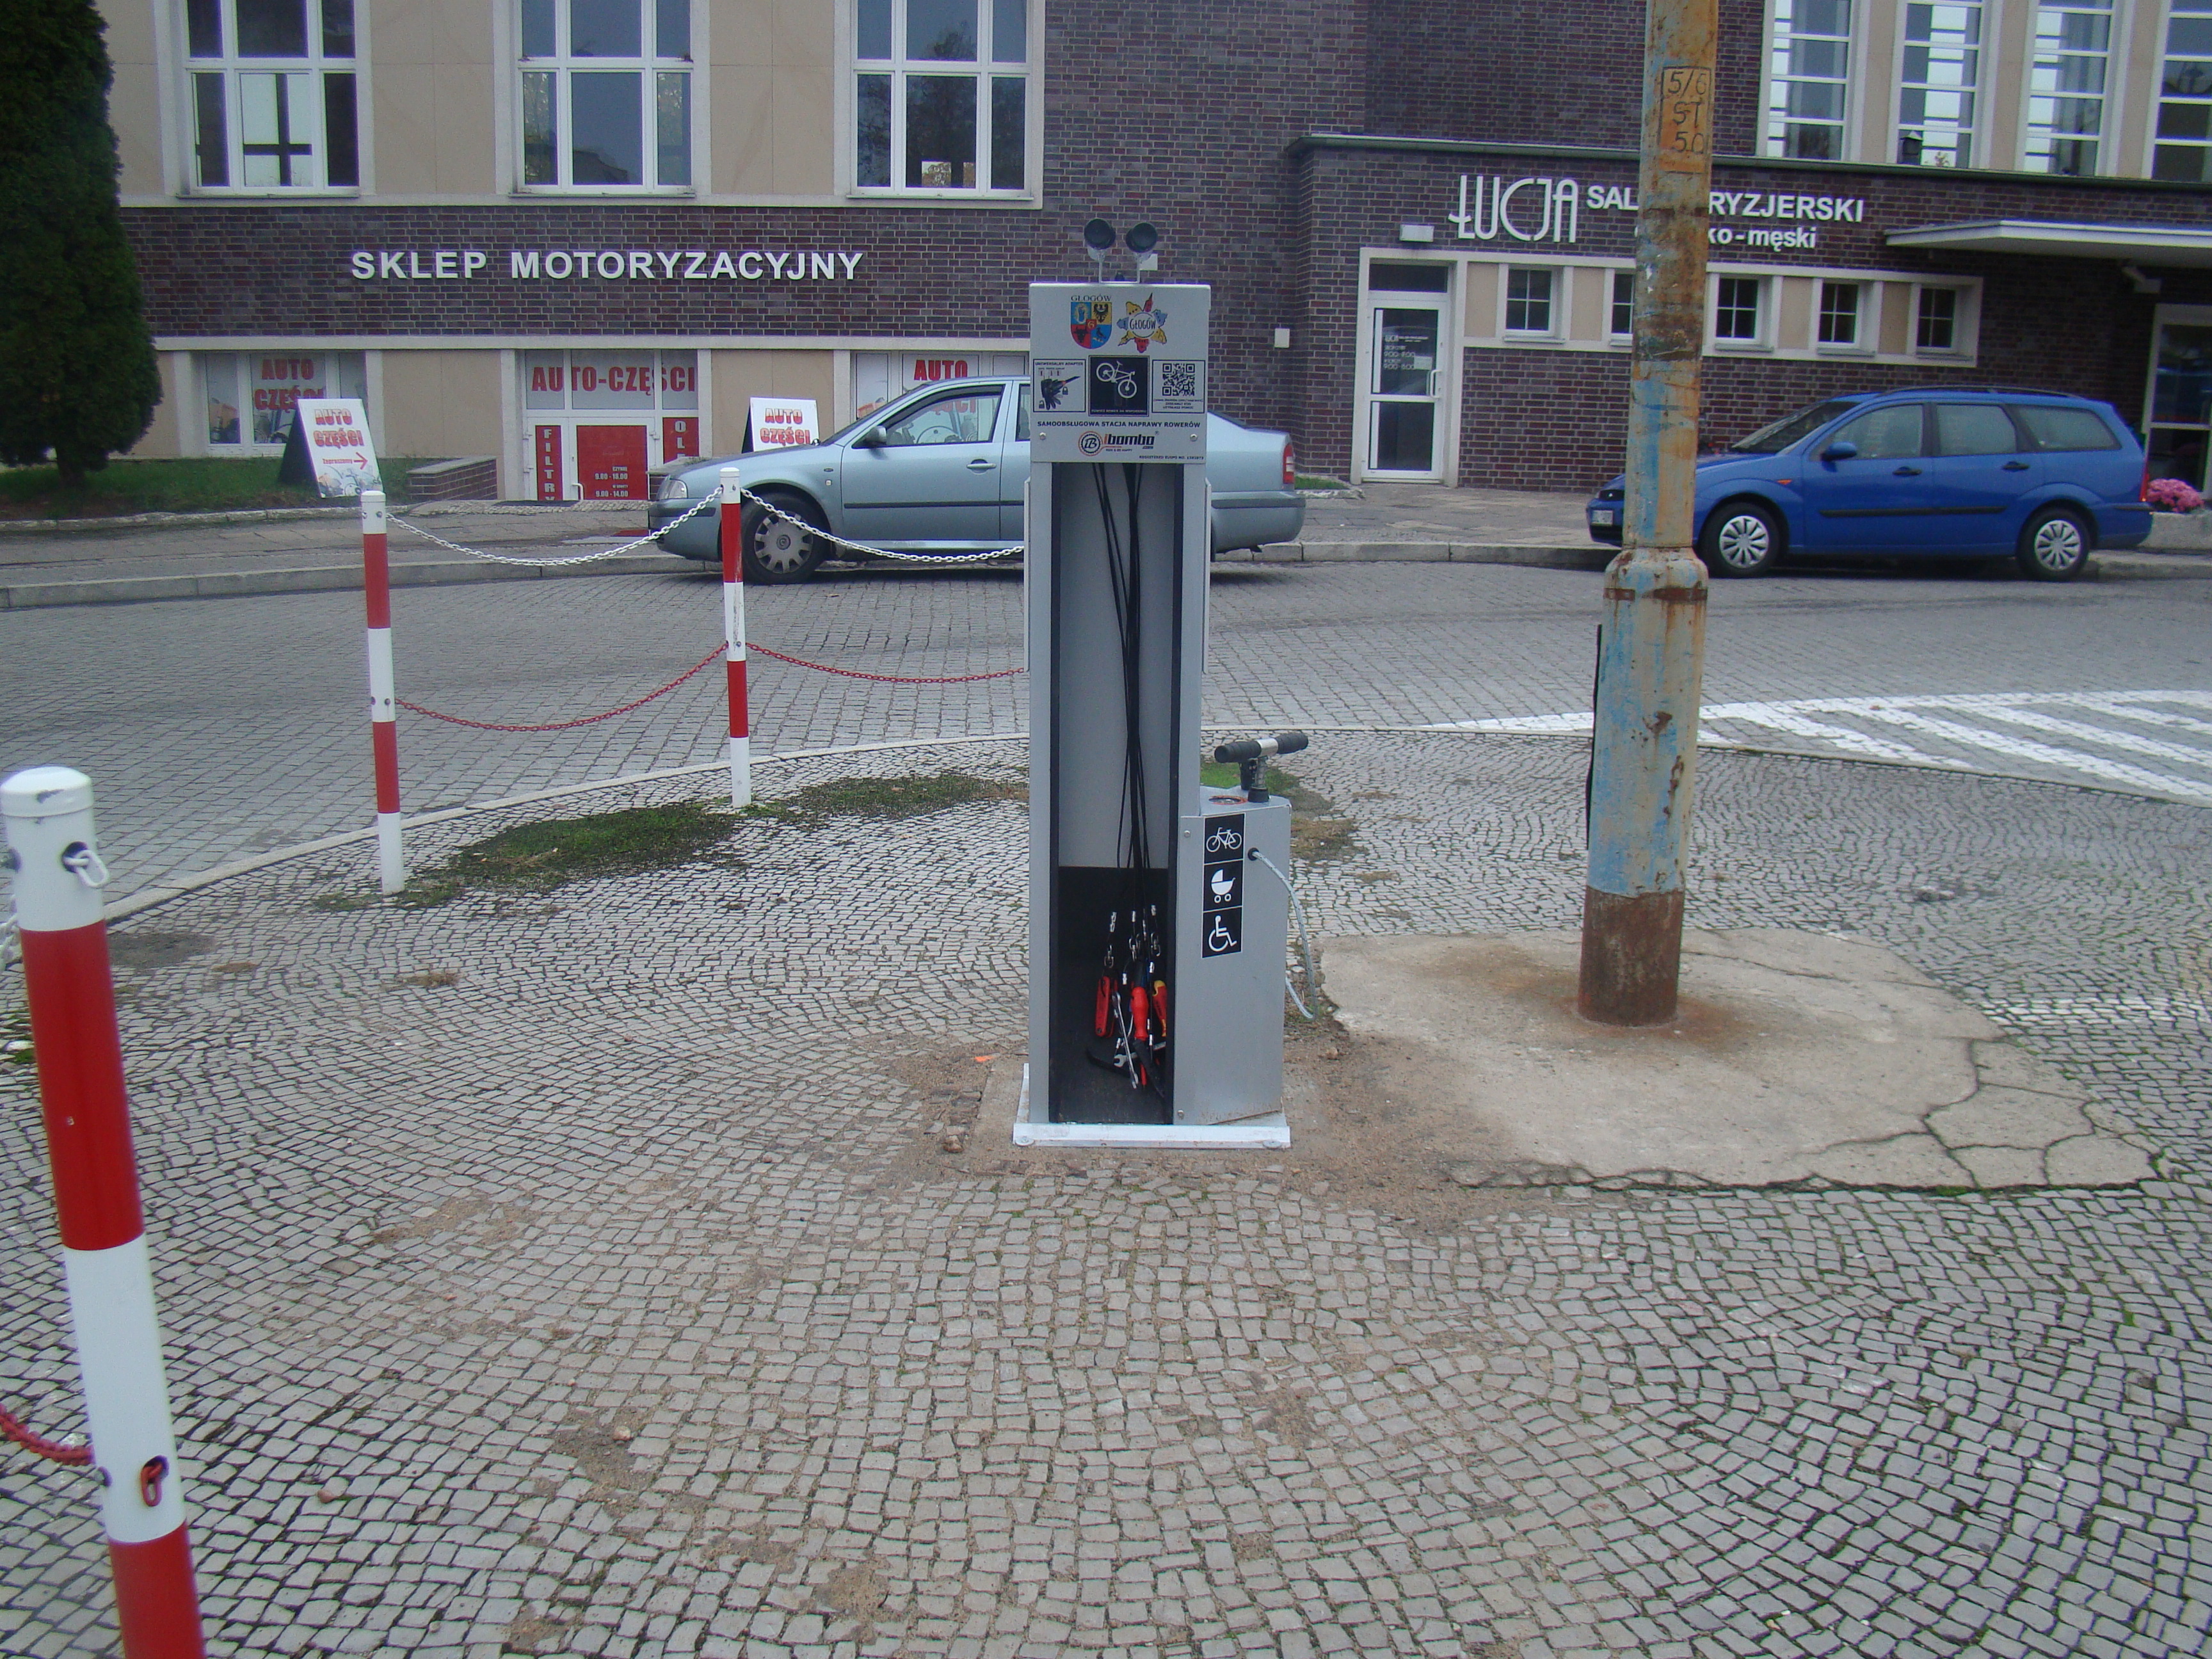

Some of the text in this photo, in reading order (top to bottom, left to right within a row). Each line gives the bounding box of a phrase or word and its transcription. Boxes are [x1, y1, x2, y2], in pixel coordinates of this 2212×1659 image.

[1448, 174, 1579, 243] ŁUCJA
[1585, 184, 1864, 223] SAL RYZJERSKI
[351, 251, 863, 280] SKLEP MOTORYZACYJNY
[1130, 317, 1156, 330] GŁOGÓW
[261, 358, 314, 380] AUTO
[913, 359, 968, 381] AUTO
[314, 408, 353, 426] AUTO
[765, 408, 803, 425] AUTO
[313, 427, 365, 449] CZĘŚCI
[760, 426, 810, 447] CZĘŚCI
